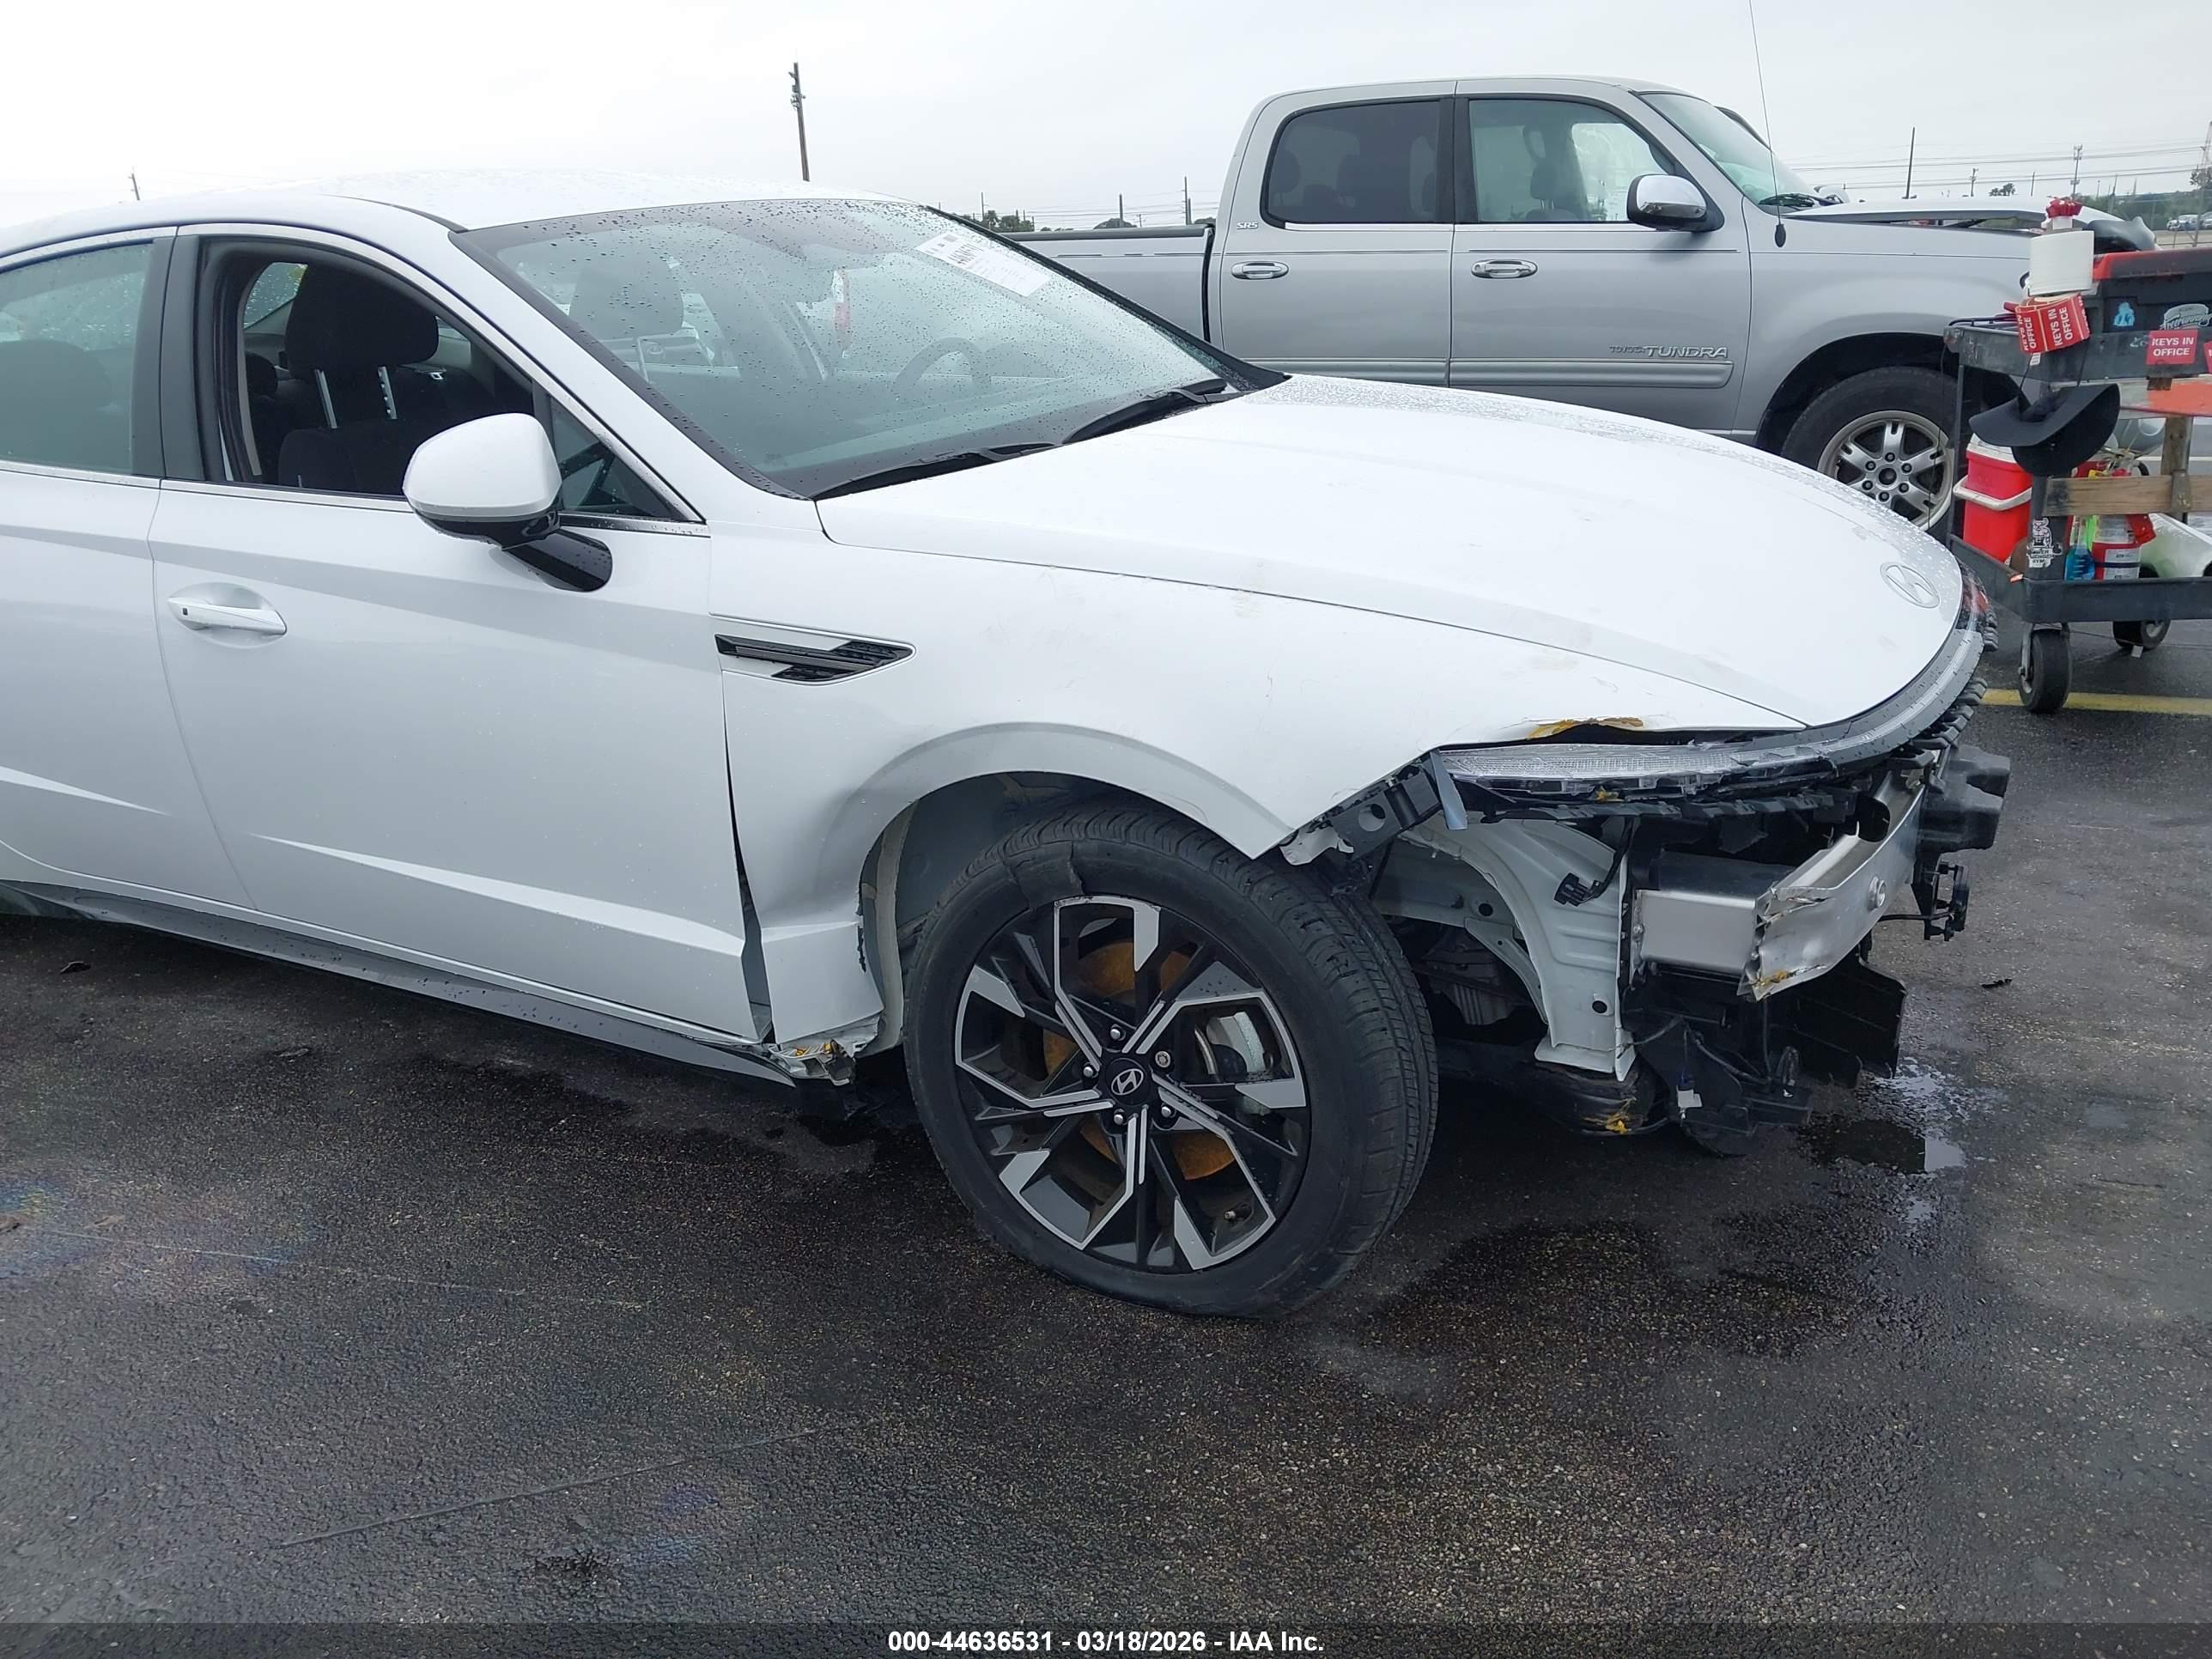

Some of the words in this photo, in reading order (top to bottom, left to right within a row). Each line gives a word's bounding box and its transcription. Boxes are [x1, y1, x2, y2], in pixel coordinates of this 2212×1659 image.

[2048, 308, 2057, 320] IN
[2059, 307, 2074, 340] OFFICE
[2024, 317, 2037, 349] OFFICE
[2050, 320, 2063, 346] KEYS
[2151, 337, 2179, 346] KEYS
[2182, 337, 2195, 345] IN
[1643, 345, 1728, 358] TUNDRA
[2153, 347, 2191, 357] OFFICE
